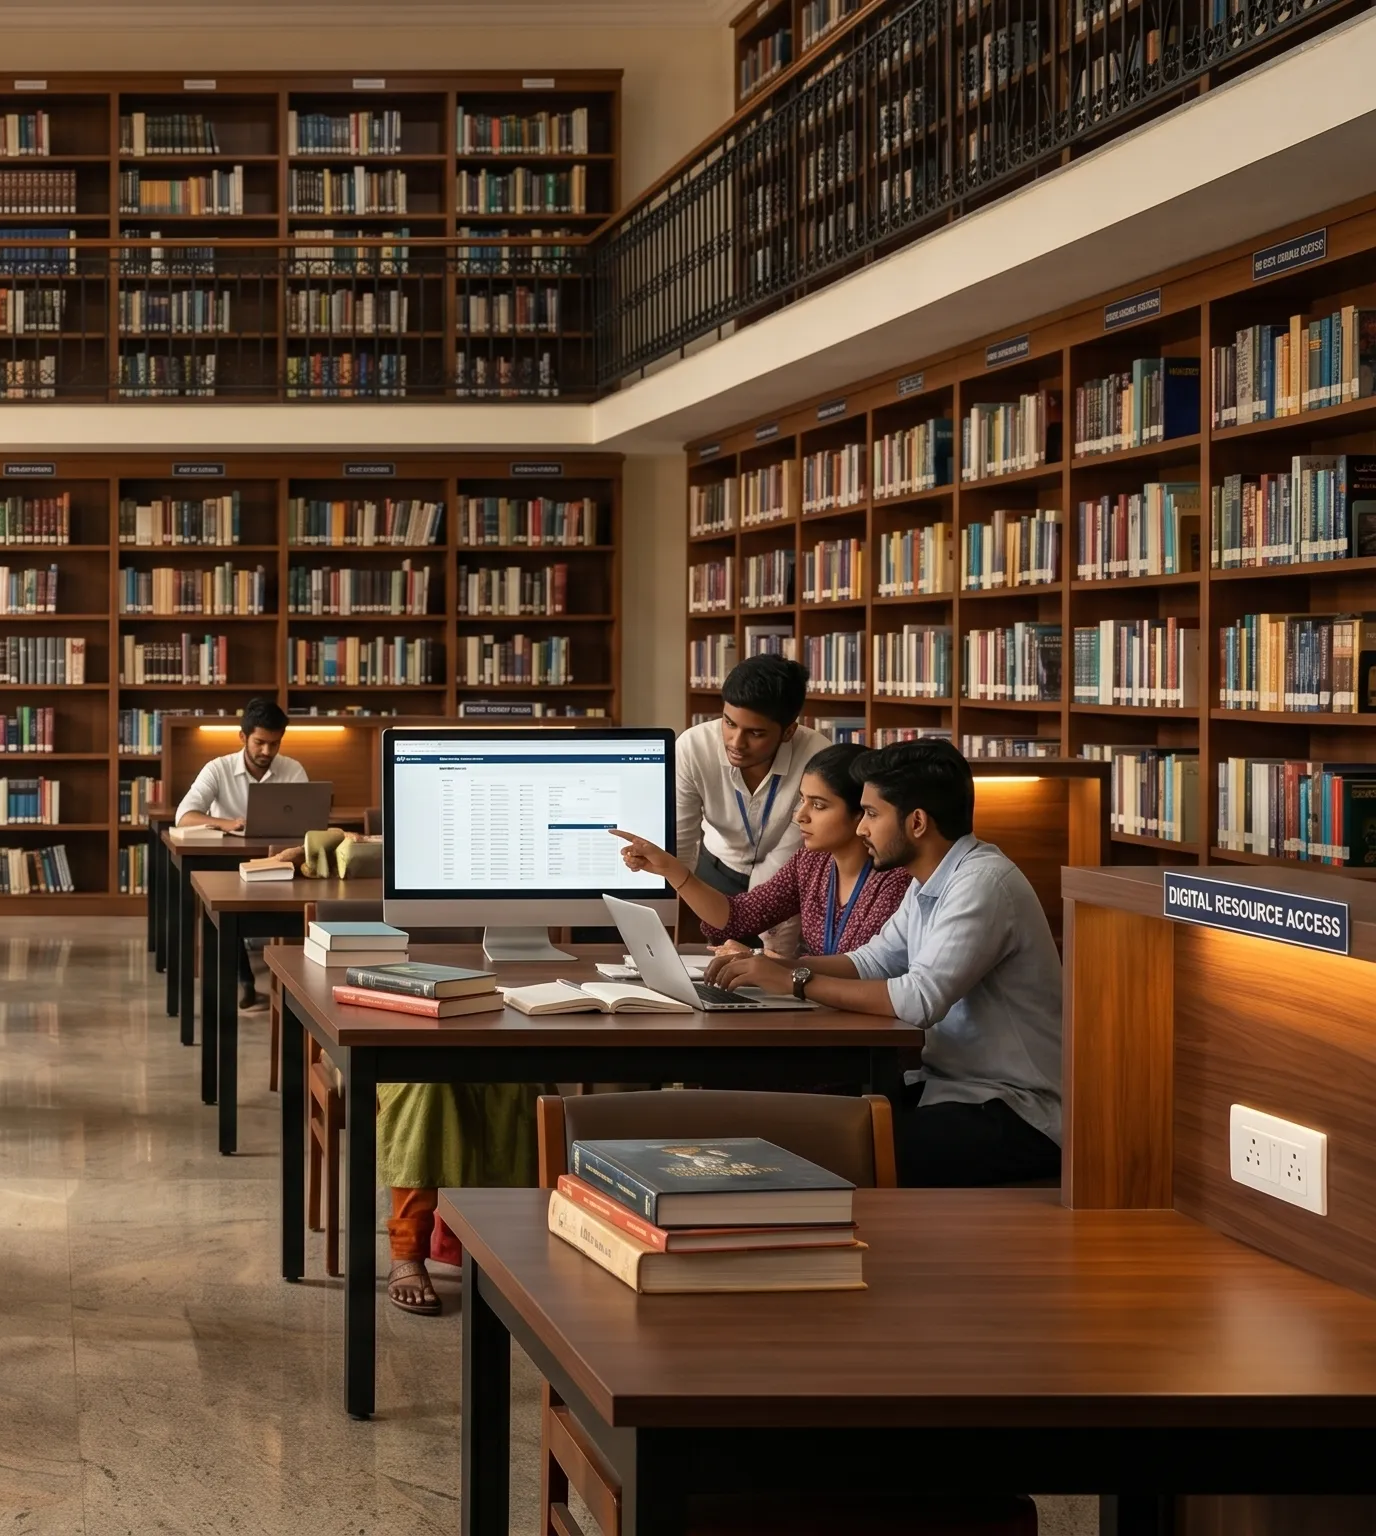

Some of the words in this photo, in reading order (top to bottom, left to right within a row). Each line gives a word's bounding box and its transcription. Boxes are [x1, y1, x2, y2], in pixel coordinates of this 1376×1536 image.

[1169, 886, 1213, 911] DIGITAL
[1215, 895, 1284, 926] RESOURCE
[1286, 909, 1341, 938] ACCESS
